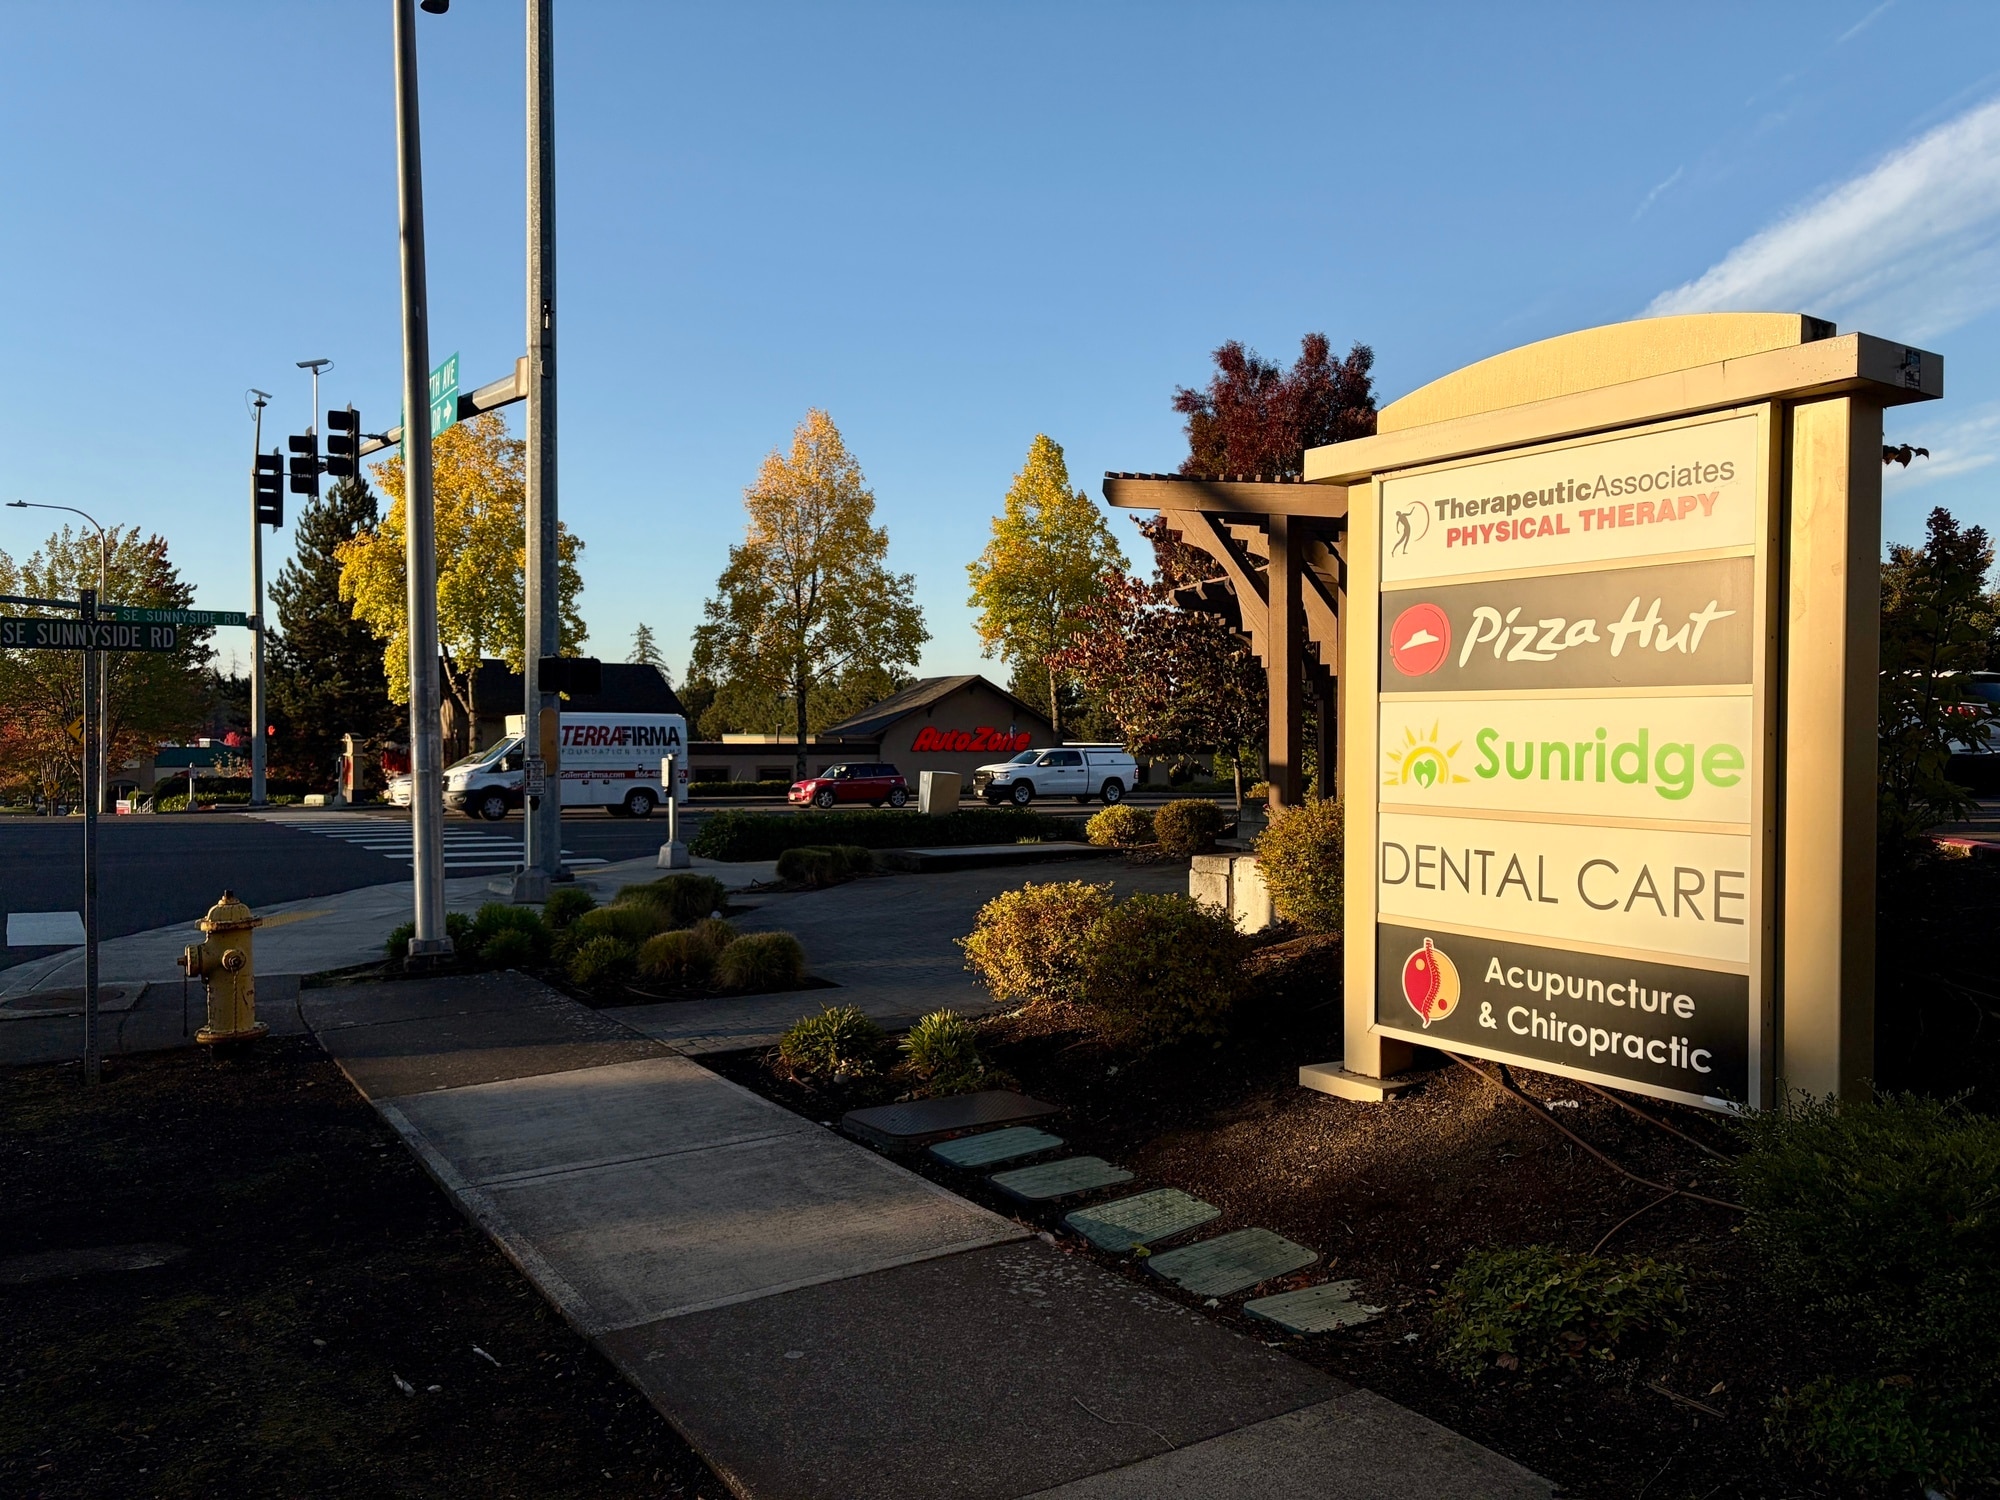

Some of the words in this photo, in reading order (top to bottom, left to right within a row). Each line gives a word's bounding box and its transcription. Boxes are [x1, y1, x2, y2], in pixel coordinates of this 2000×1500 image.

[442, 358, 455, 391] AVE
[432, 406, 441, 434] DR
[1434, 460, 1735, 521] TherapeuticAssociates
[1446, 513, 1570, 548] PHYSICAL
[1579, 491, 1719, 531] THERAPY
[3, 622, 27, 644] SE
[36, 623, 142, 648] SUNNYSIDE
[150, 627, 174, 648] RD
[122, 609, 139, 622] SE
[146, 610, 216, 625] SUNNYSIDE
[224, 614, 240, 625] RD
[1458, 606, 1600, 668] Pizza
[1607, 596, 1736, 657] Hut
[561, 725, 681, 747] TERRAFIRMA
[911, 726, 1032, 753] AutoZone
[1474, 726, 1745, 801] Sunridge
[1382, 841, 1559, 905] DENTAL
[1577, 858, 1745, 926] CARE
[1484, 956, 1696, 1020] Acupuncture
[1478, 1001, 1498, 1030] &
[1506, 1005, 1713, 1074] Chiropractic
